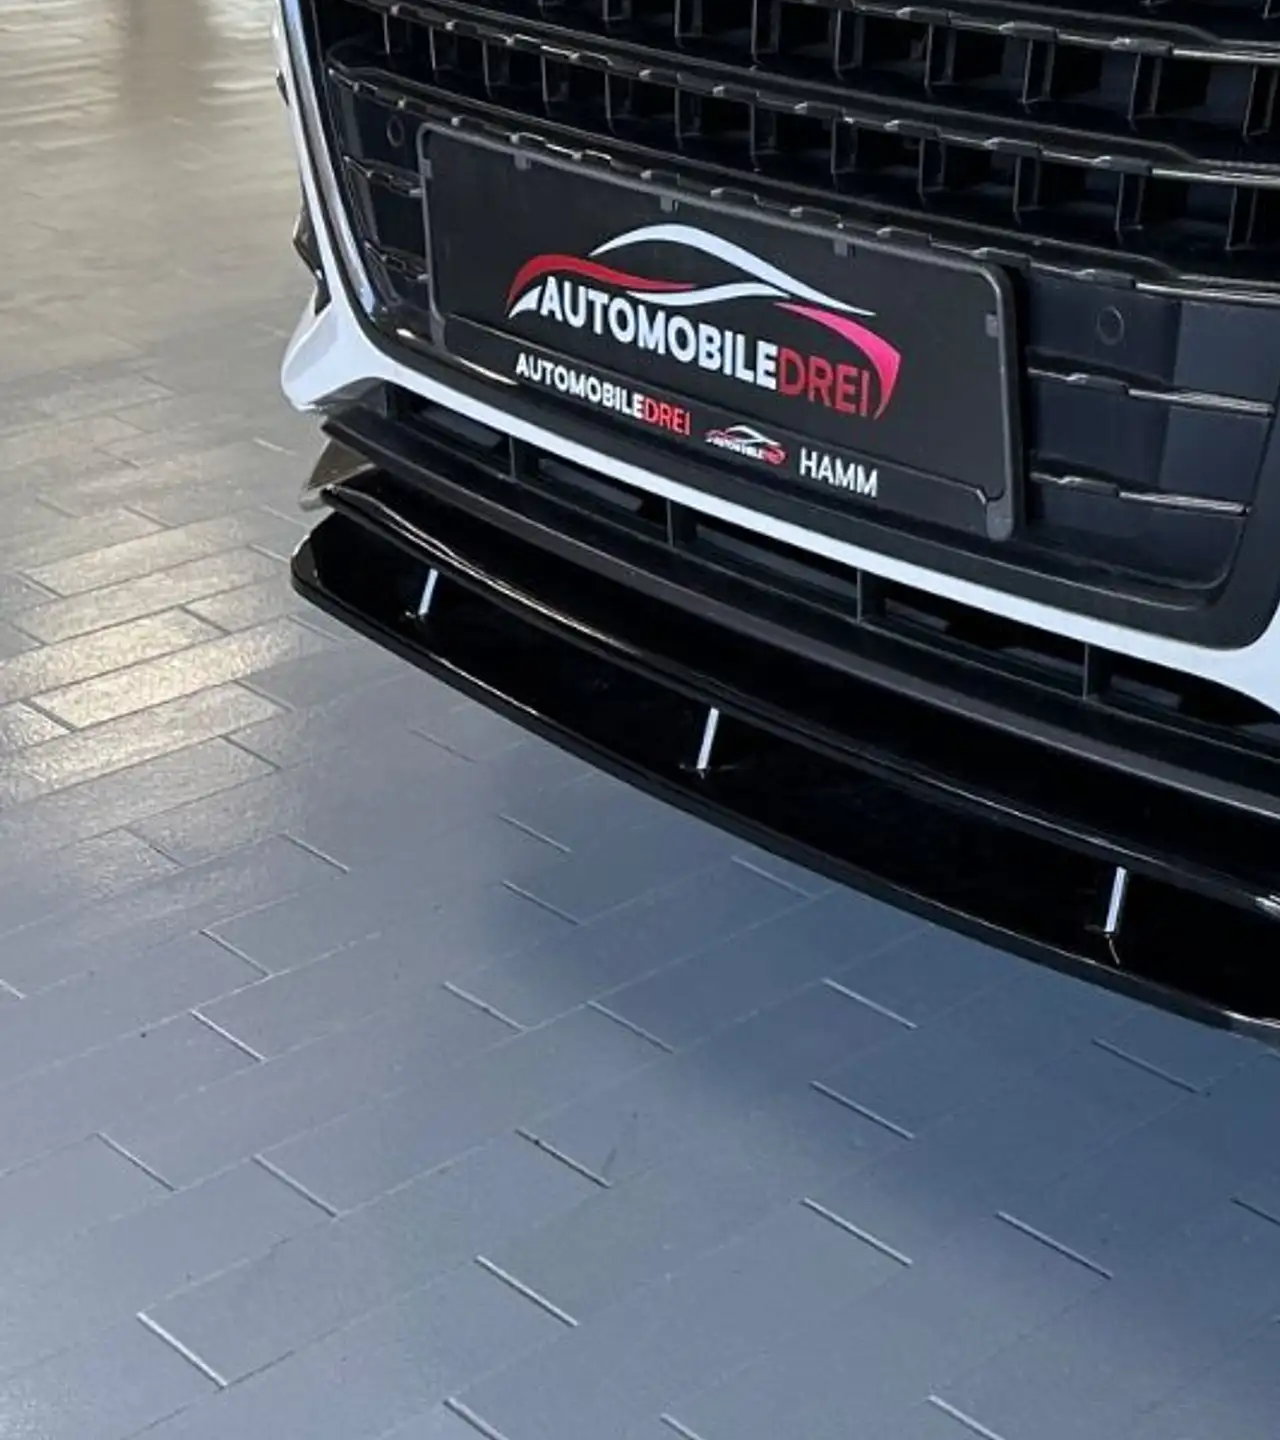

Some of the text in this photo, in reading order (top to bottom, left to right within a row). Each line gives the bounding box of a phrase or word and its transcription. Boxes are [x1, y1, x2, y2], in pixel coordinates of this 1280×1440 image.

[539, 276, 870, 416] AUTOMOBILEDREI
[516, 352, 690, 436] AUTOMOBILEDREI
[799, 449, 878, 498] HAMM
